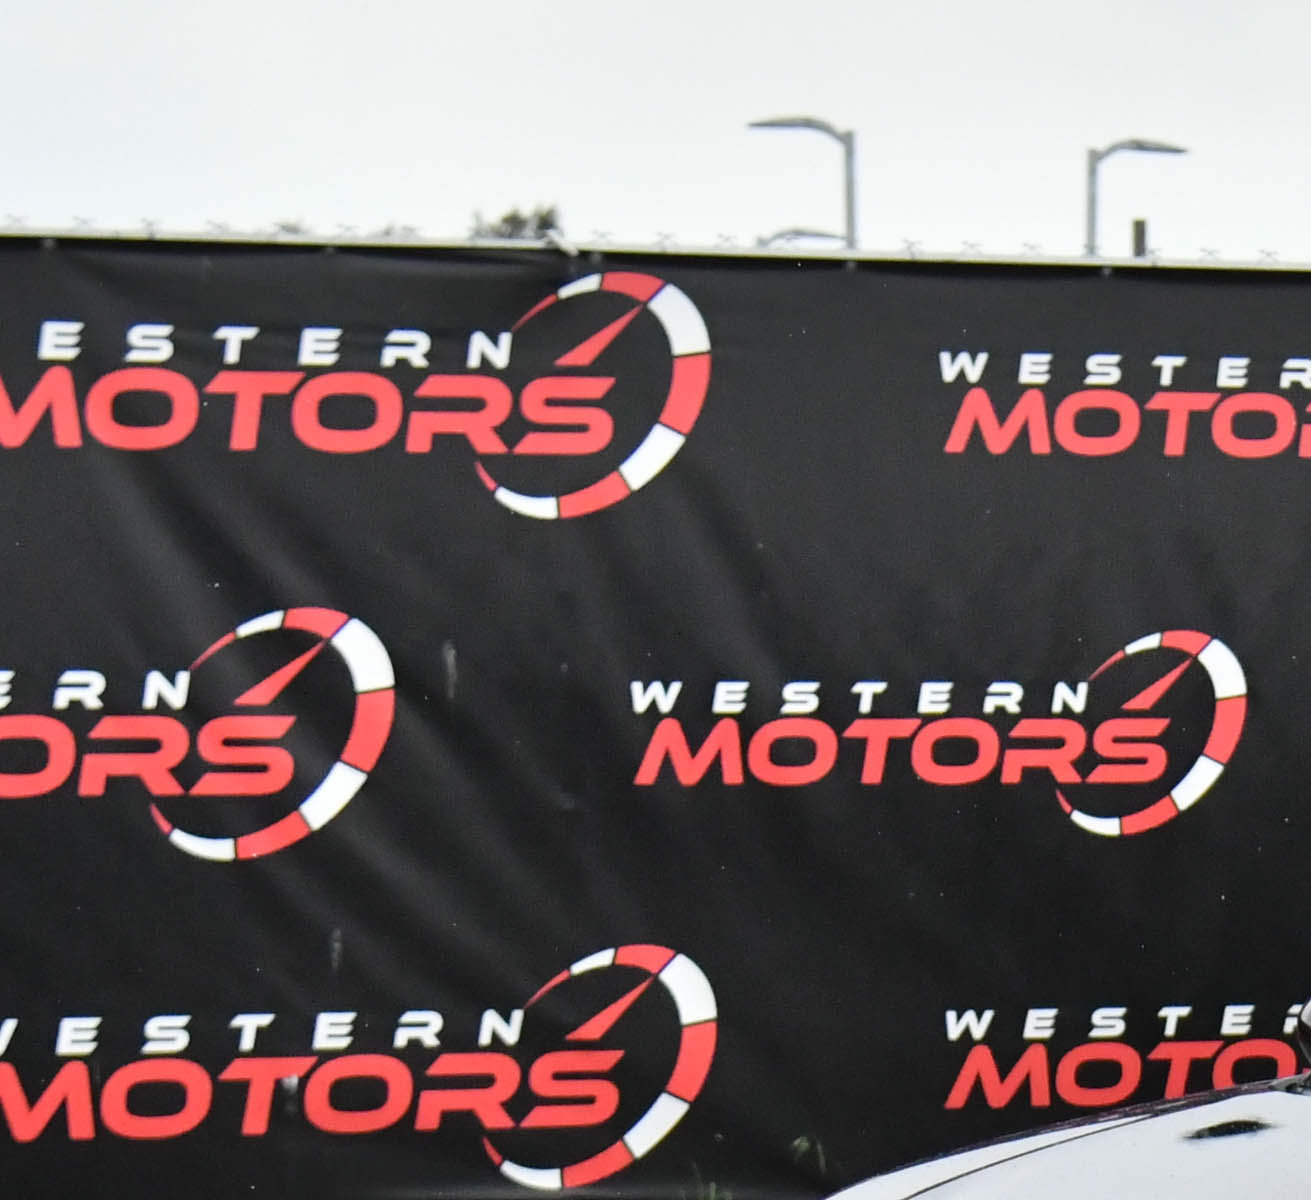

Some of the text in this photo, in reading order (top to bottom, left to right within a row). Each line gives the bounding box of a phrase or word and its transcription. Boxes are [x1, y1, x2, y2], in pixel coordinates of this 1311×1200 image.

[38, 321, 513, 370] ESTERN
[0, 366, 617, 456] MOTORS
[630, 680, 1089, 715] WESTERN
[634, 717, 1171, 787] MOTORS
[0, 1050, 625, 1144] MOTORS
